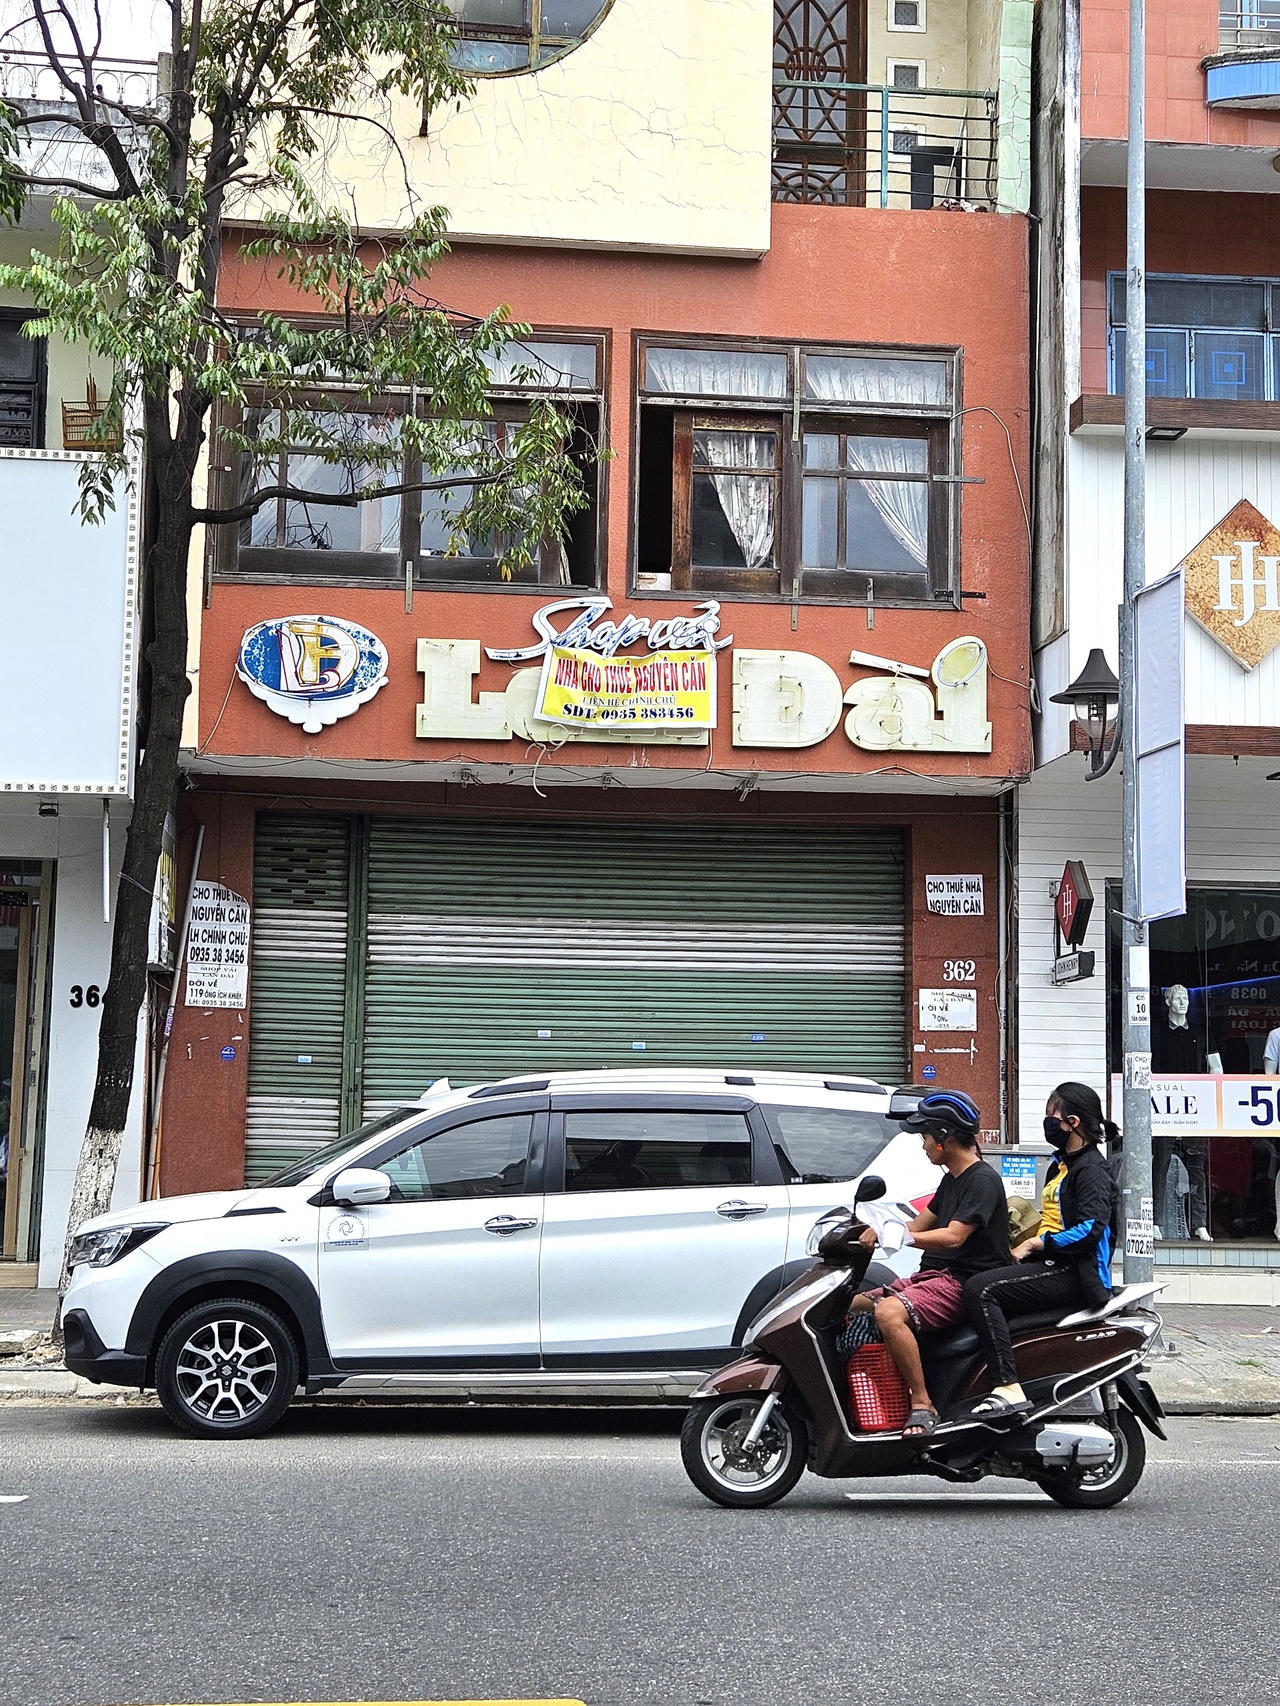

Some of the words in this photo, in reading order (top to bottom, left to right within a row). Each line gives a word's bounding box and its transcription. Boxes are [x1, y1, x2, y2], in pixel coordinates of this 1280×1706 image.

[554, 655, 579, 690] NHÀ
[581, 661, 602, 693] CHO
[605, 660, 633, 694] THUÊ
[634, 656, 679, 694] NGUYÊN
[682, 655, 707, 692] CĂN
[602, 707, 637, 720] 0935
[641, 707, 694, 719] 383456
[192, 886, 211, 900] CHO
[927, 881, 945, 894] CHO
[946, 879, 964, 893] THUÊ
[965, 878, 982, 893] NHÀ
[191, 903, 226, 922] NGUYÊN
[228, 905, 248, 923] CĂN
[929, 896, 962, 914] NGUYÊN
[963, 896, 982, 914] CĂN
[189, 927, 200, 943] LH
[201, 926, 228, 945] CHÍNH
[190, 946, 211, 962] 0935
[212, 948, 223, 963] 38
[224, 949, 245, 965] 3456
[943, 959, 976, 982] 362
[70, 984, 107, 1009] 36
[190, 988, 204, 998] 119
[1136, 1002, 1146, 1014] 10
[1150, 1095, 1199, 1115] ALE
[1238, 1086, 1280, 1127] -5
